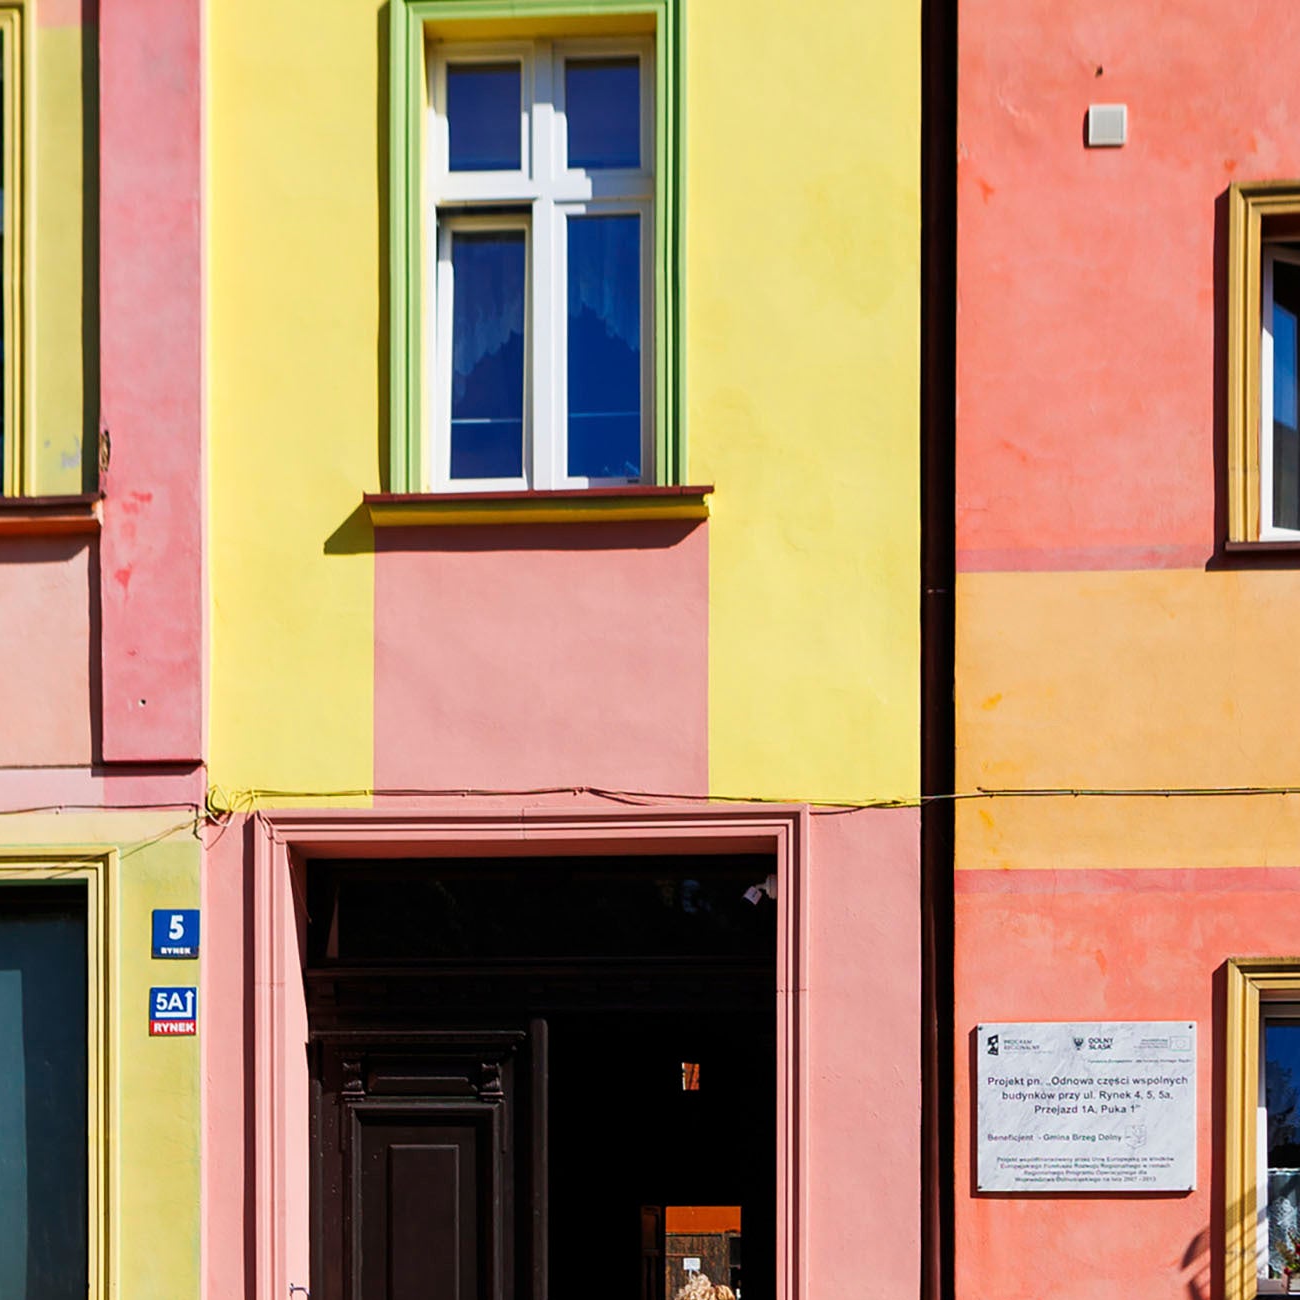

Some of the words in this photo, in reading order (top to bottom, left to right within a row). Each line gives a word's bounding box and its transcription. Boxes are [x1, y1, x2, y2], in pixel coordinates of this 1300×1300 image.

[168, 914, 185, 941] 5
[160, 946, 191, 955] RYNEK
[155, 992, 184, 1011] 5A
[153, 1022, 195, 1033] RYNEK
[987, 1077, 1024, 1087] Projekt
[1026, 1079, 1044, 1087] pn.
[1096, 1076, 1130, 1087] części
[1002, 1091, 1055, 1102] budynków
[1058, 1092, 1080, 1101] przy
[1083, 1091, 1096, 1100] ul.
[1099, 1091, 1131, 1101] Rynek
[1034, 1105, 1078, 1116] Przejazd
[1101, 1105, 1127, 1114] Puka
[987, 1133, 1034, 1143] Beneficjent
[1043, 1133, 1070, 1142] Gmina
[1072, 1133, 1096, 1143] Brzeg
[1098, 1133, 1122, 1143] Dolny
